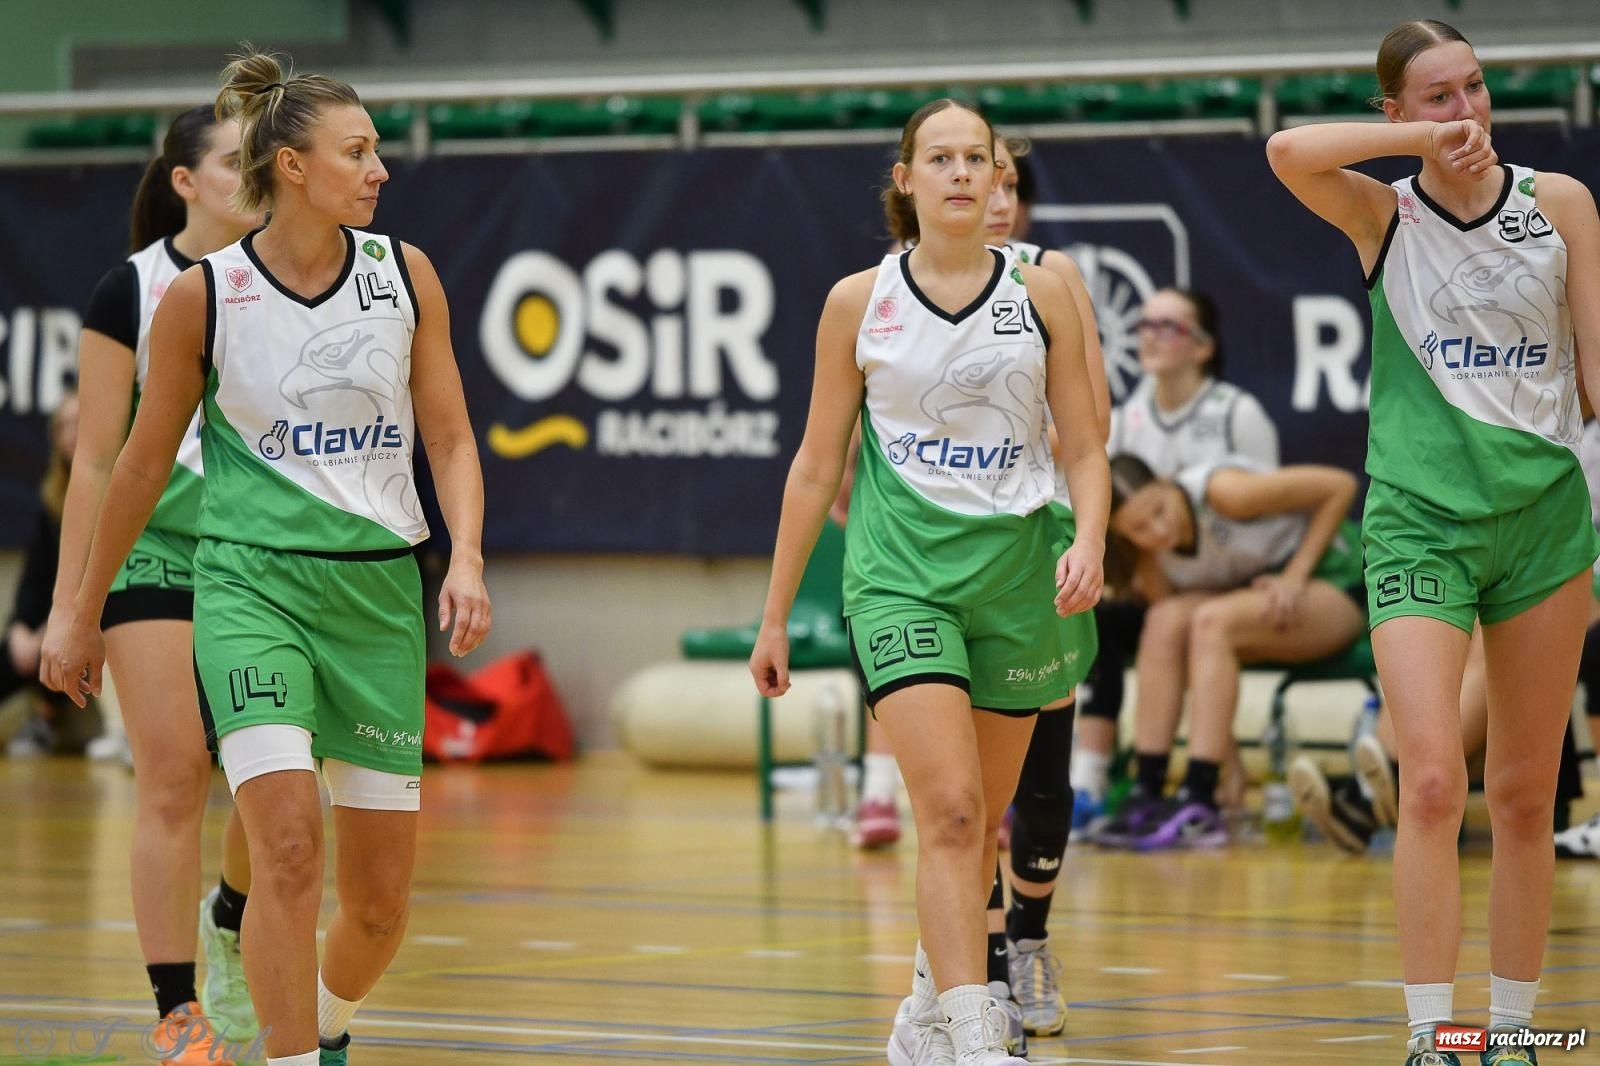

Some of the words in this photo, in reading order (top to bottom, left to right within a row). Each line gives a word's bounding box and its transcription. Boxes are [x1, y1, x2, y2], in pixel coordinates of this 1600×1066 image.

[1498, 207, 1553, 242] 30
[355, 272, 398, 311] 14
[1440, 336, 1549, 369] Clavis
[292, 415, 402, 456] Clavis
[597, 401, 780, 457] RACIBÓRZ
[916, 437, 1025, 469] Clavis
[1377, 569, 1446, 609] 30
[869, 620, 943, 672] 26
[229, 666, 287, 712] 14
